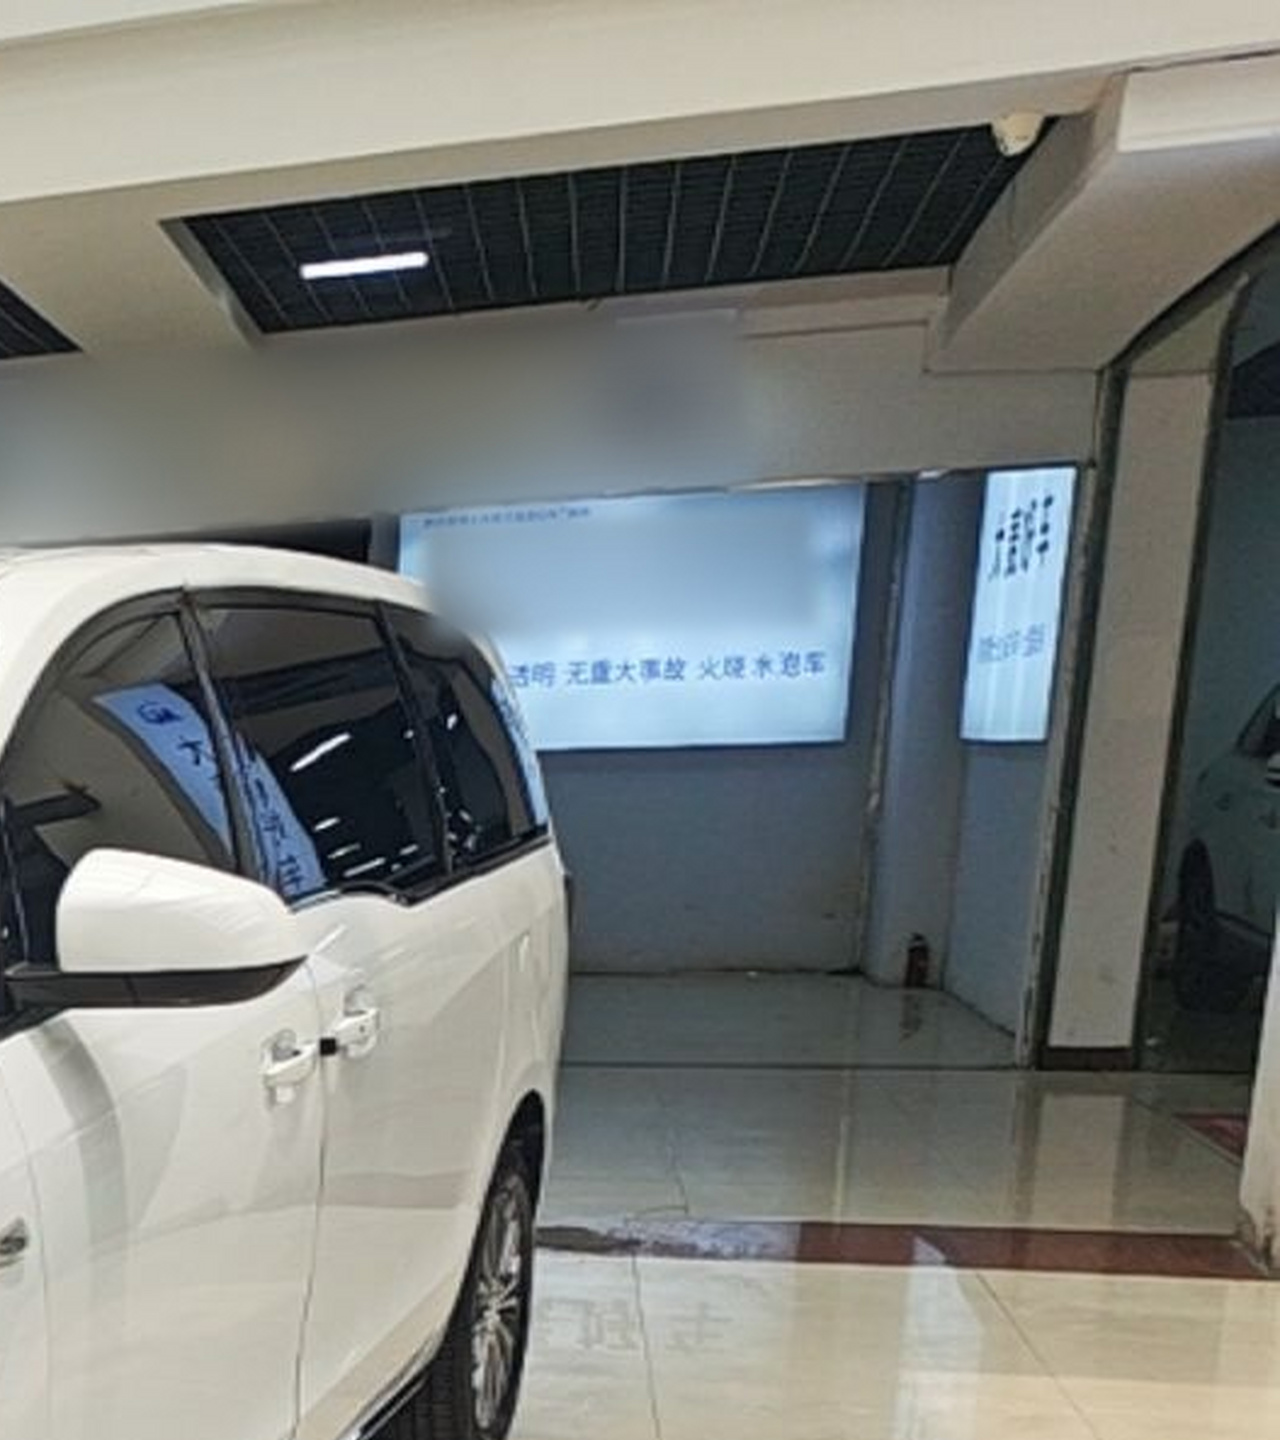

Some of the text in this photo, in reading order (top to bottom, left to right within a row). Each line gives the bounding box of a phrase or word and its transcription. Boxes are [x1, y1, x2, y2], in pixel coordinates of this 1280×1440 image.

[567, 656, 687, 687] 无重大事故
